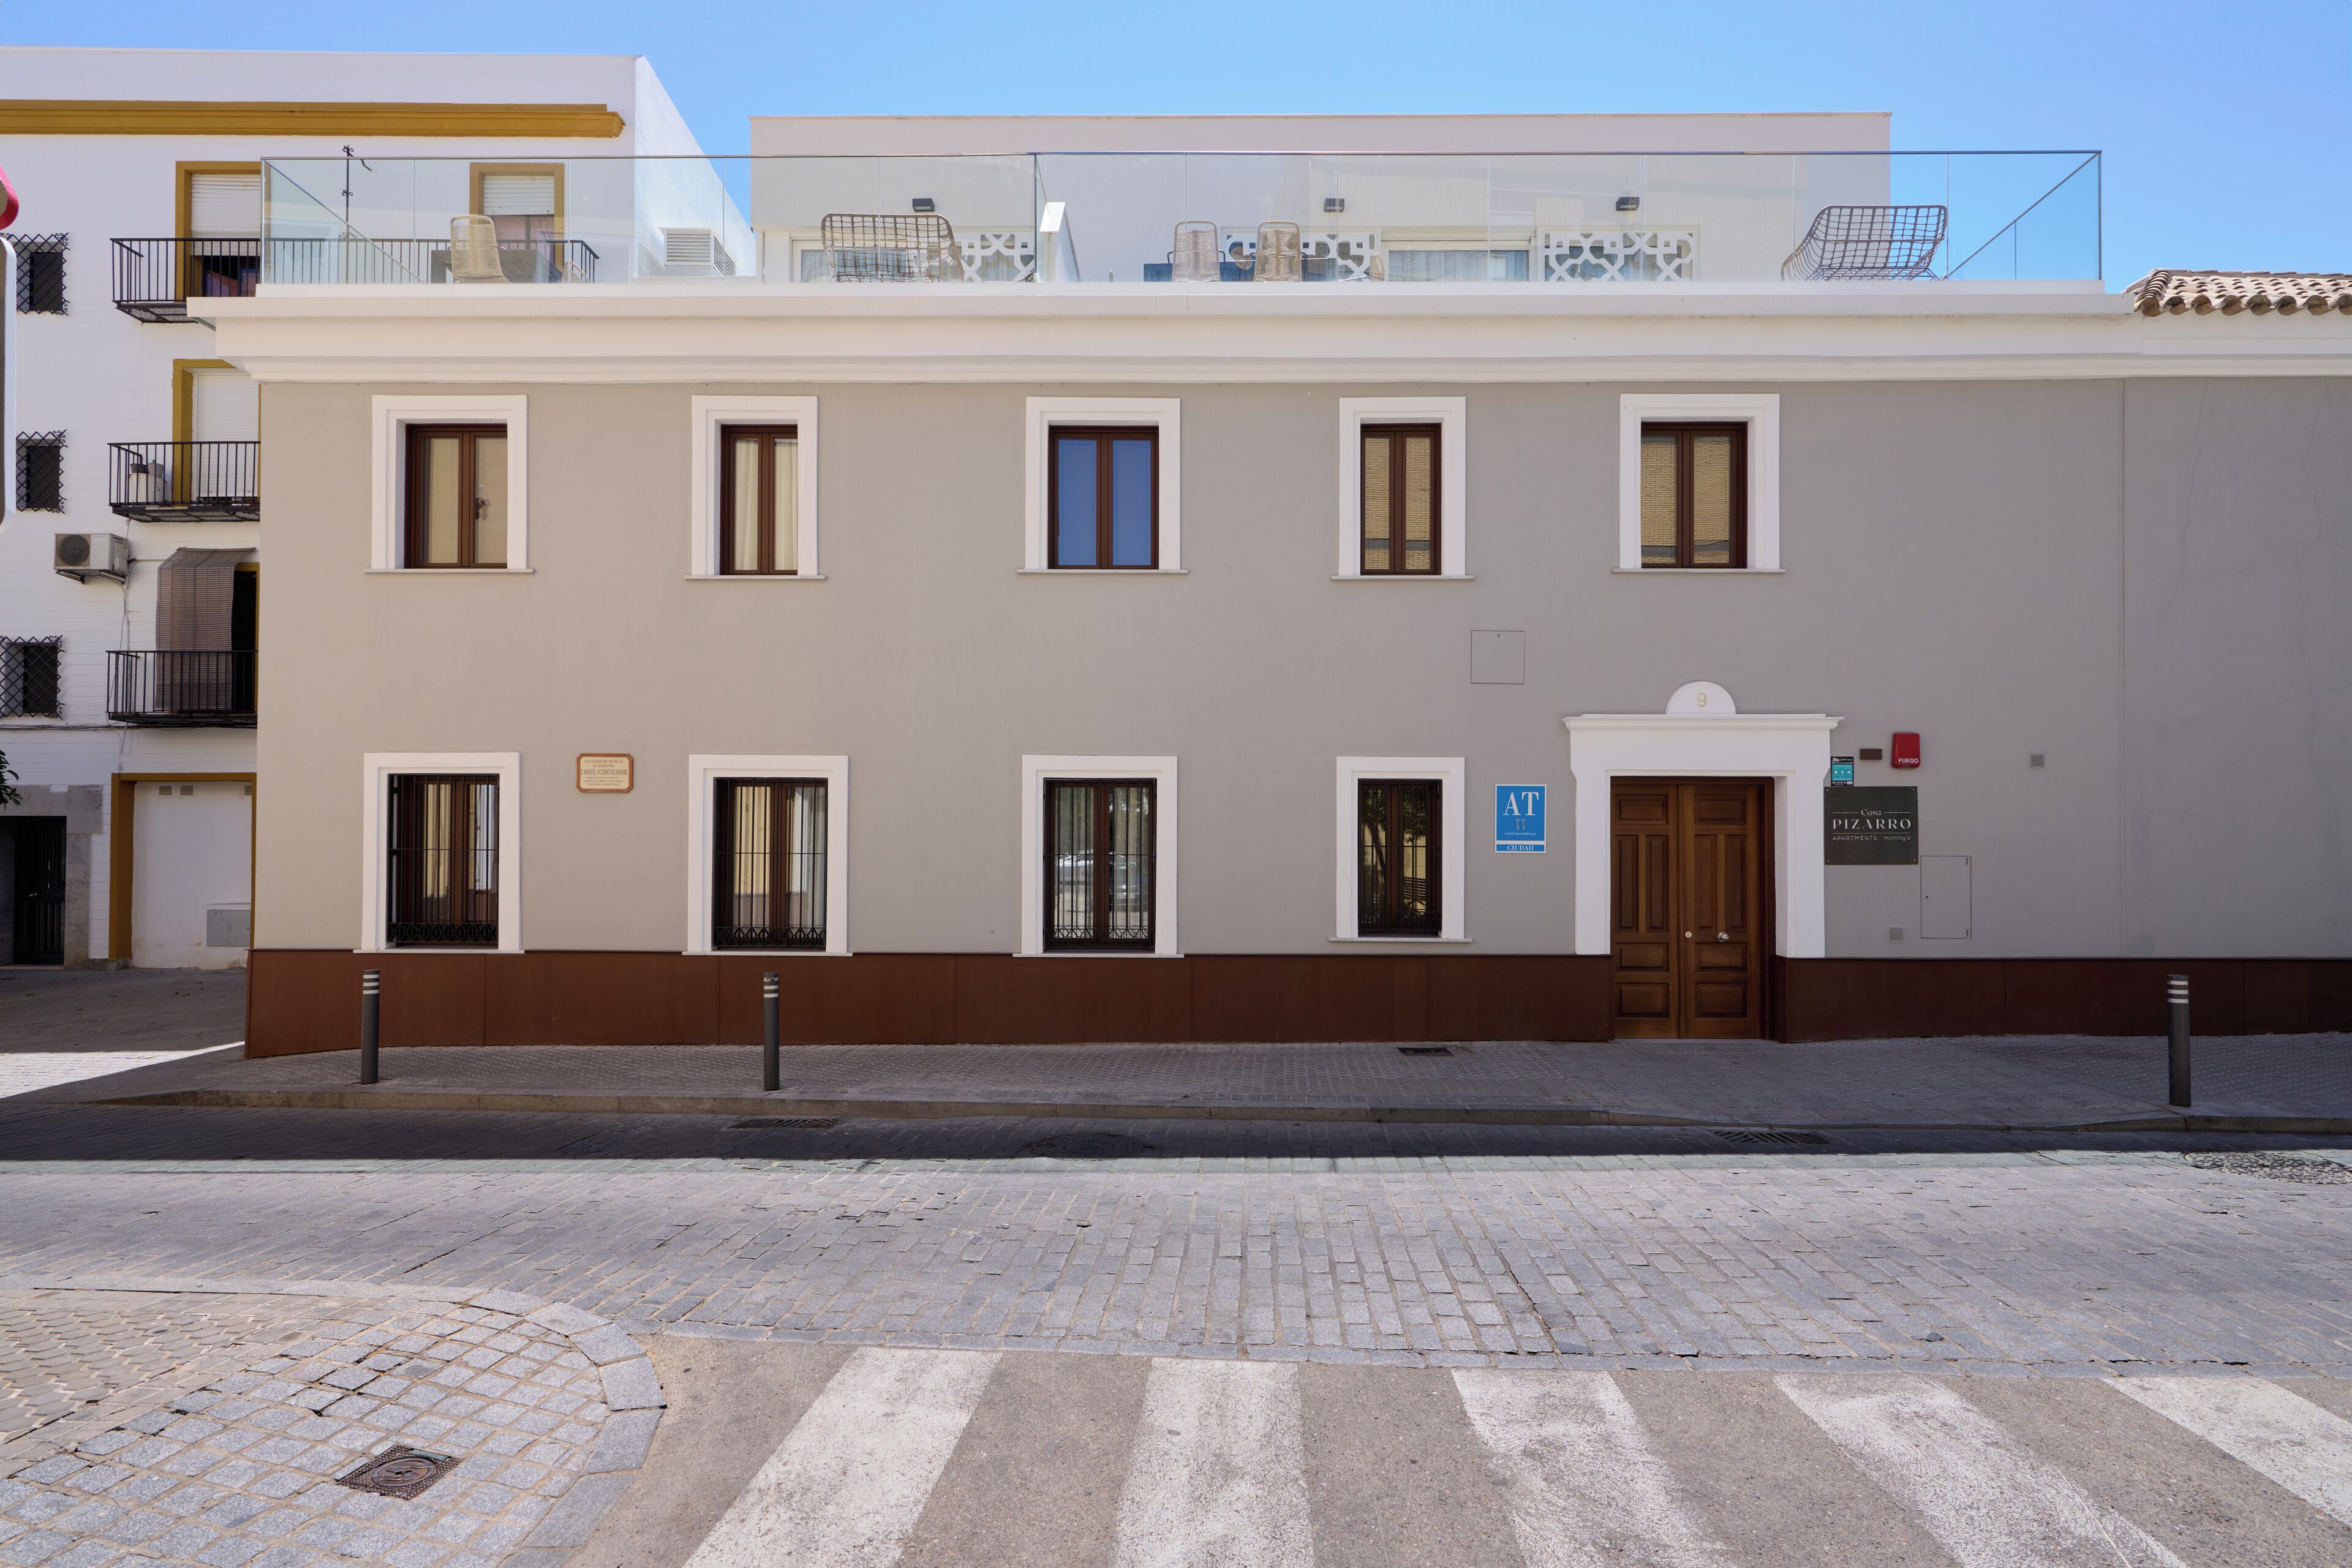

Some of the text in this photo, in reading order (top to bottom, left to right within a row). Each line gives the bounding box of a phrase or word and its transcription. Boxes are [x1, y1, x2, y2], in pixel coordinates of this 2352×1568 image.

[1697, 692, 1707, 707] 9
[1502, 791, 1539, 816] AT
[1833, 818, 1911, 829] PIZARRO
